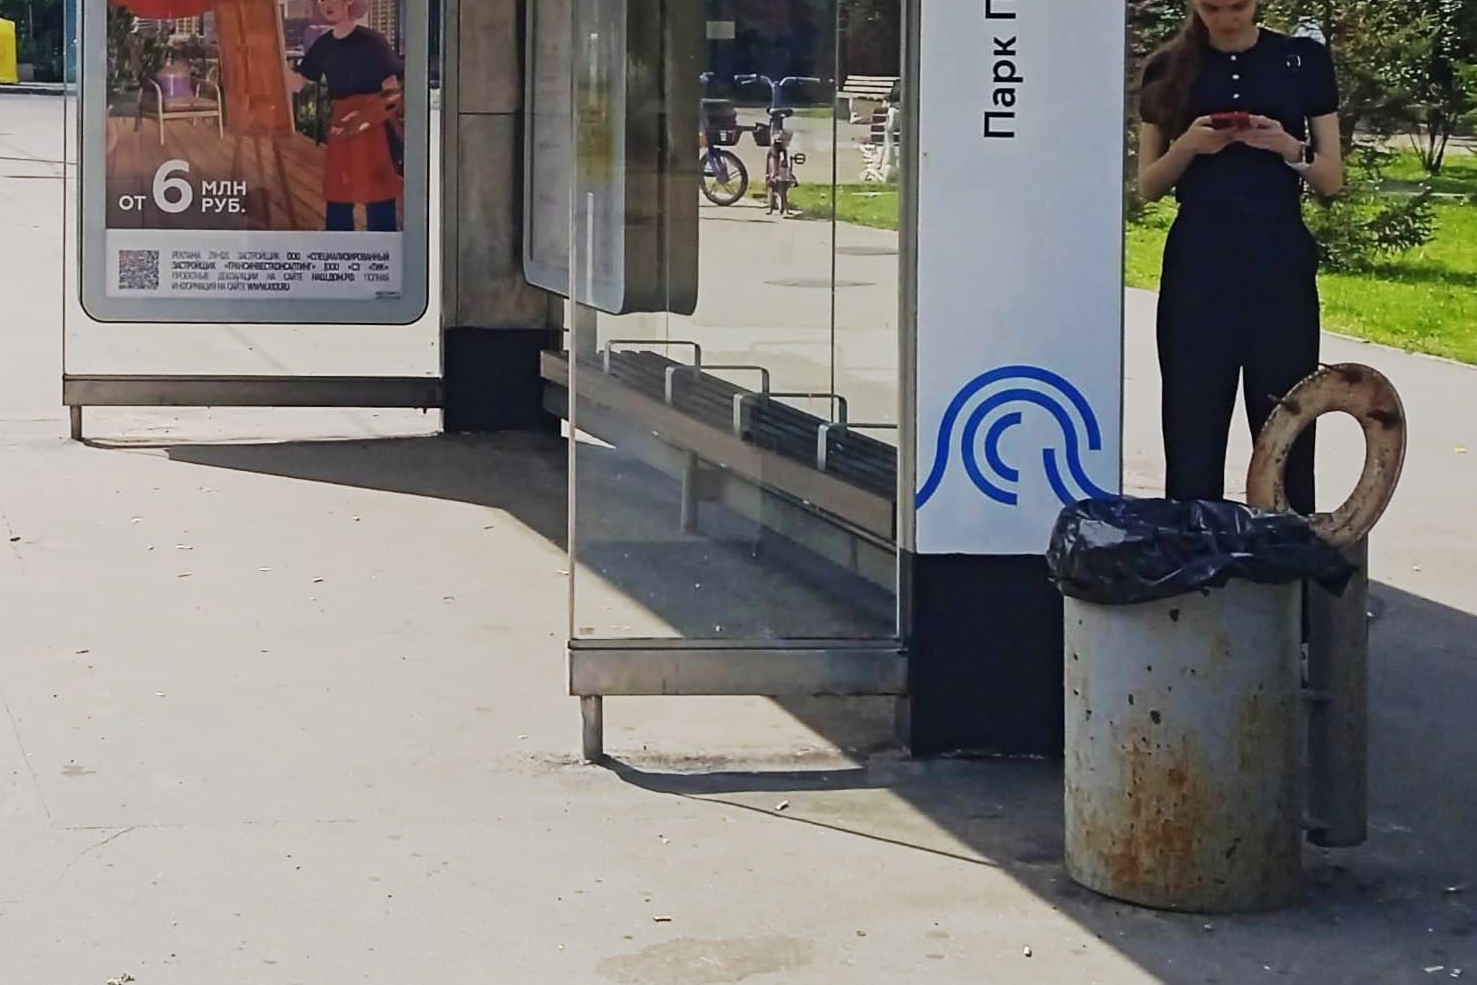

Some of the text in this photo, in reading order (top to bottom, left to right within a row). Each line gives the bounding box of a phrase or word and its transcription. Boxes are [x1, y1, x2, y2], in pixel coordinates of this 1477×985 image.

[984, 36, 1023, 138] Парк
[119, 159, 193, 213] ОТ 6
[202, 181, 246, 196] МЛН
[202, 198, 246, 213] РУБ.
